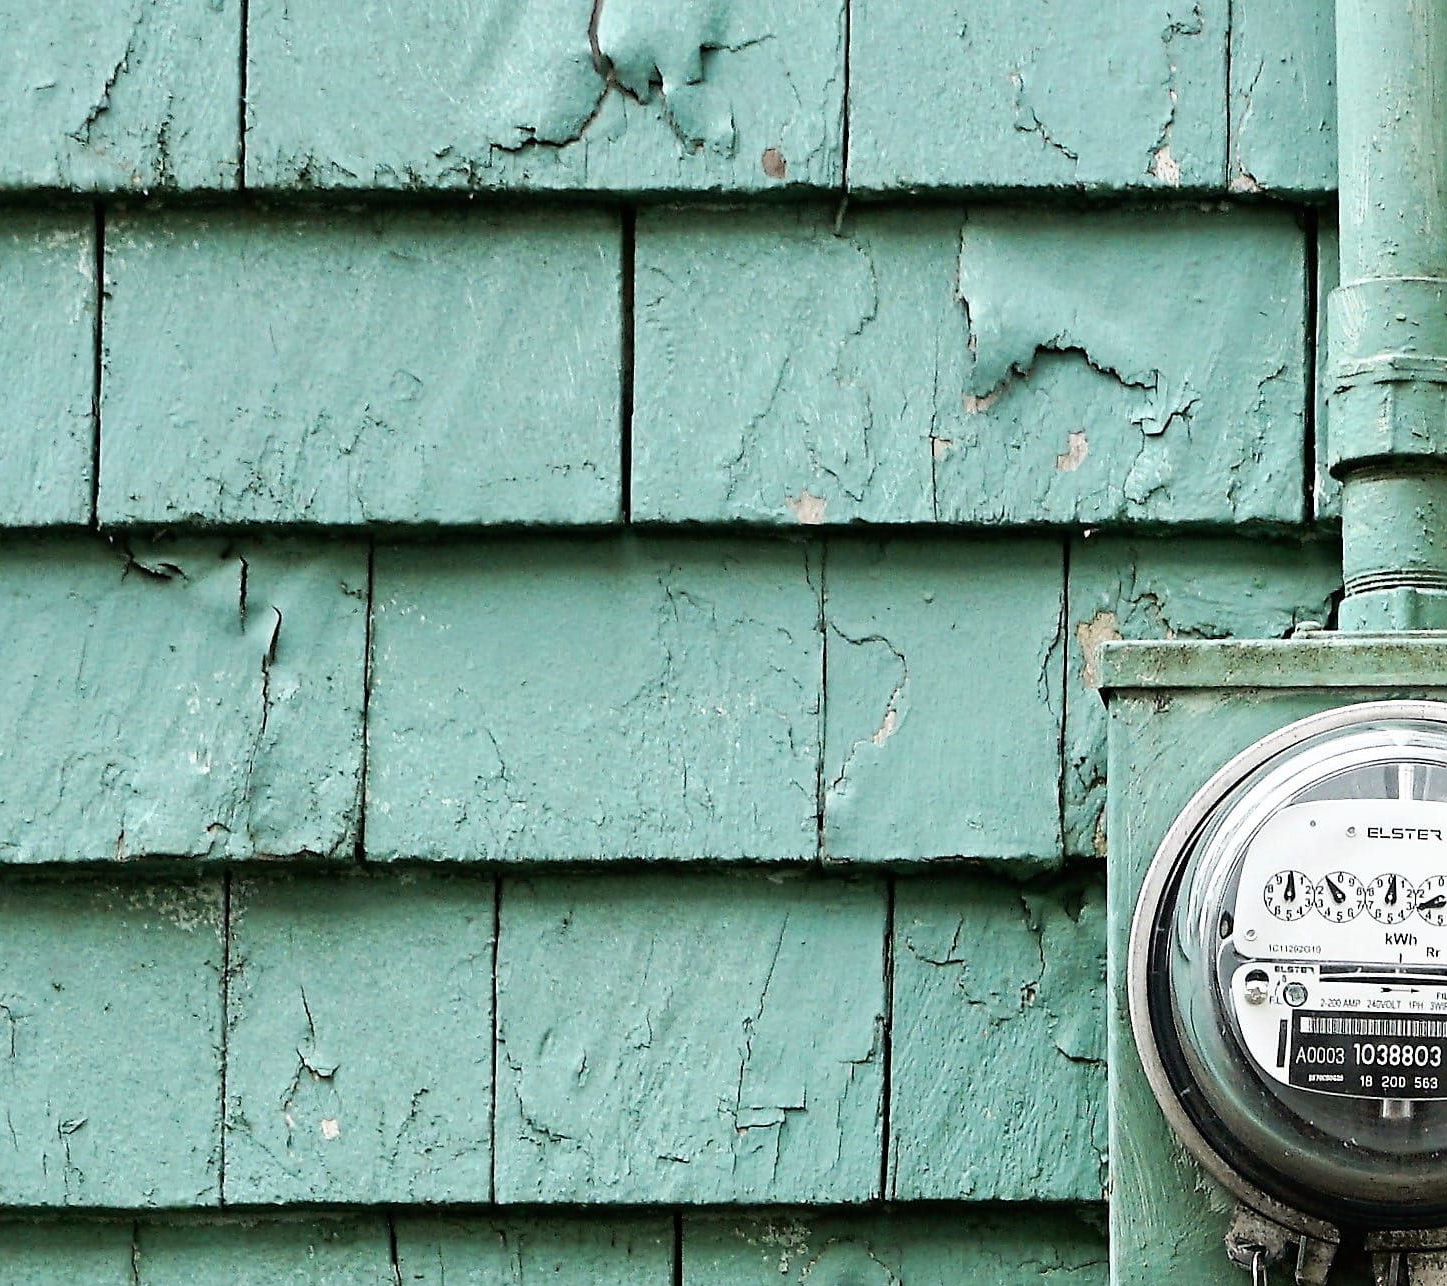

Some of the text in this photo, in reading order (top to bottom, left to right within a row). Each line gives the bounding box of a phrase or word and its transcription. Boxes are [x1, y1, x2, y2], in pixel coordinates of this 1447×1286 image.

[1367, 827, 1443, 841] ELSTER
[1385, 932, 1418, 946] kWh
[1426, 946, 1440, 958] Rr
[1295, 1046, 1345, 1064] A0003
[1354, 1043, 1442, 1067] 1038803
[1360, 1075, 1373, 1087] 18
[1414, 1077, 1438, 1089] 563
